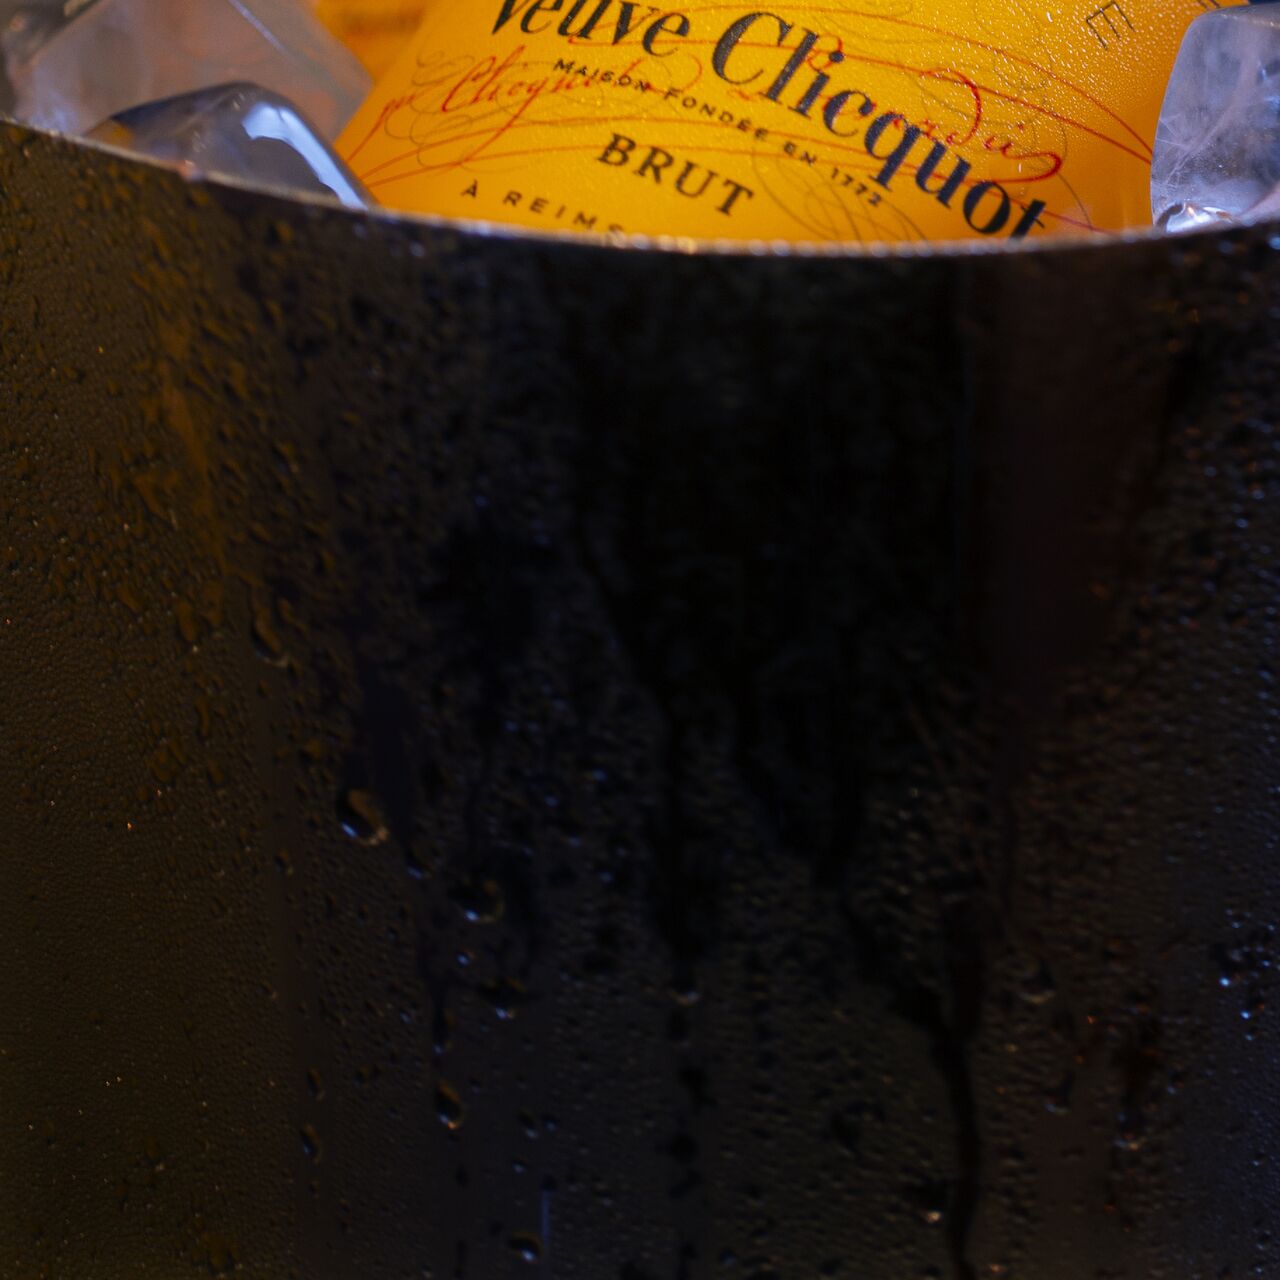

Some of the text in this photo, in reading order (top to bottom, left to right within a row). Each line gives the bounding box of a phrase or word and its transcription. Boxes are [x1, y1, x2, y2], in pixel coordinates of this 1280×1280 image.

[552, 57, 649, 93] MAISON
[783, 140, 818, 167] EN
[831, 166, 883, 208] 1772
[597, 132, 754, 217] BRUT
[711, 11, 1047, 240] Clicquot
